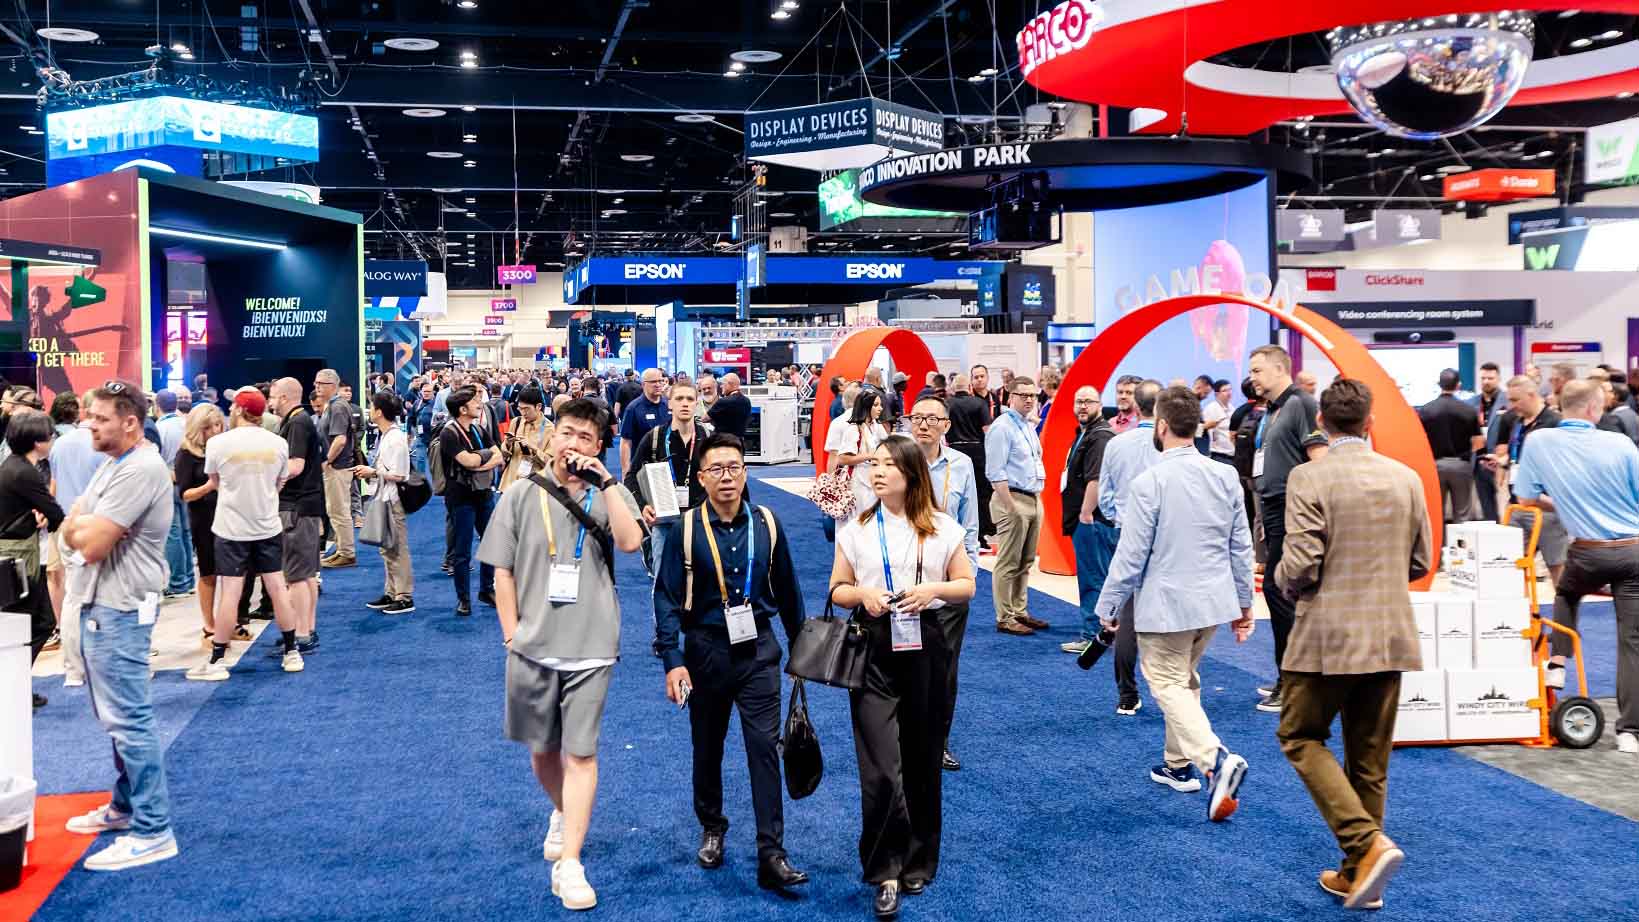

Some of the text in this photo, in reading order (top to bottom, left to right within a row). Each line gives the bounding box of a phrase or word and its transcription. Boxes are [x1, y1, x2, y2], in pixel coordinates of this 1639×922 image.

[750, 108, 867, 138] DISPLAY DEVICES
[876, 109, 942, 139] DISPLAY DEVICES
[750, 127, 867, 148] Design Engineering Manufacturing
[877, 150, 962, 182] INNOVATION
[974, 144, 1032, 167] PARK
[394, 272, 418, 280] WAY
[502, 271, 532, 280] 3300
[624, 264, 685, 279] EPSON
[846, 264, 903, 278] EPSON
[1365, 274, 1424, 286] ClickShare
[245, 297, 300, 310] WELCOME!
[1338, 310, 1365, 319] Video
[1366, 310, 1424, 320] conferencing
[1451, 310, 1483, 320] system
[243, 325, 305, 338] BIENVENUX!
[50, 338, 59, 352] A
[44, 353, 66, 367] GET
[1487, 701, 1506, 709] CITY
